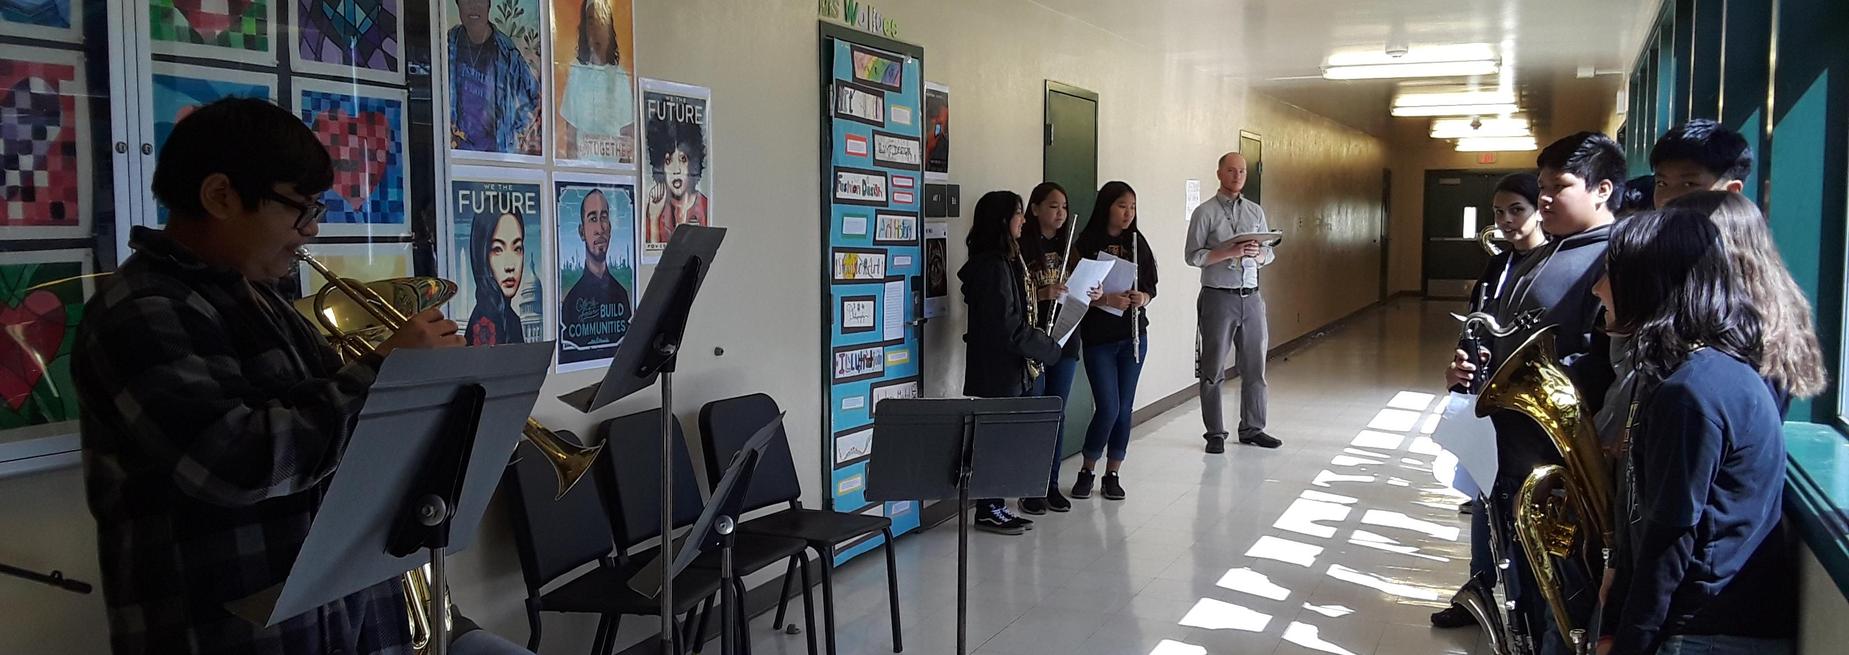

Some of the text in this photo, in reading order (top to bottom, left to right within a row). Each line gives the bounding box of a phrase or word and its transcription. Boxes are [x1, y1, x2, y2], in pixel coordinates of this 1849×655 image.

[648, 99, 703, 125] FUTURE
[458, 189, 537, 214] FUTURE
[600, 302, 625, 318] BUILD
[568, 319, 626, 338] COMMUNITIES
